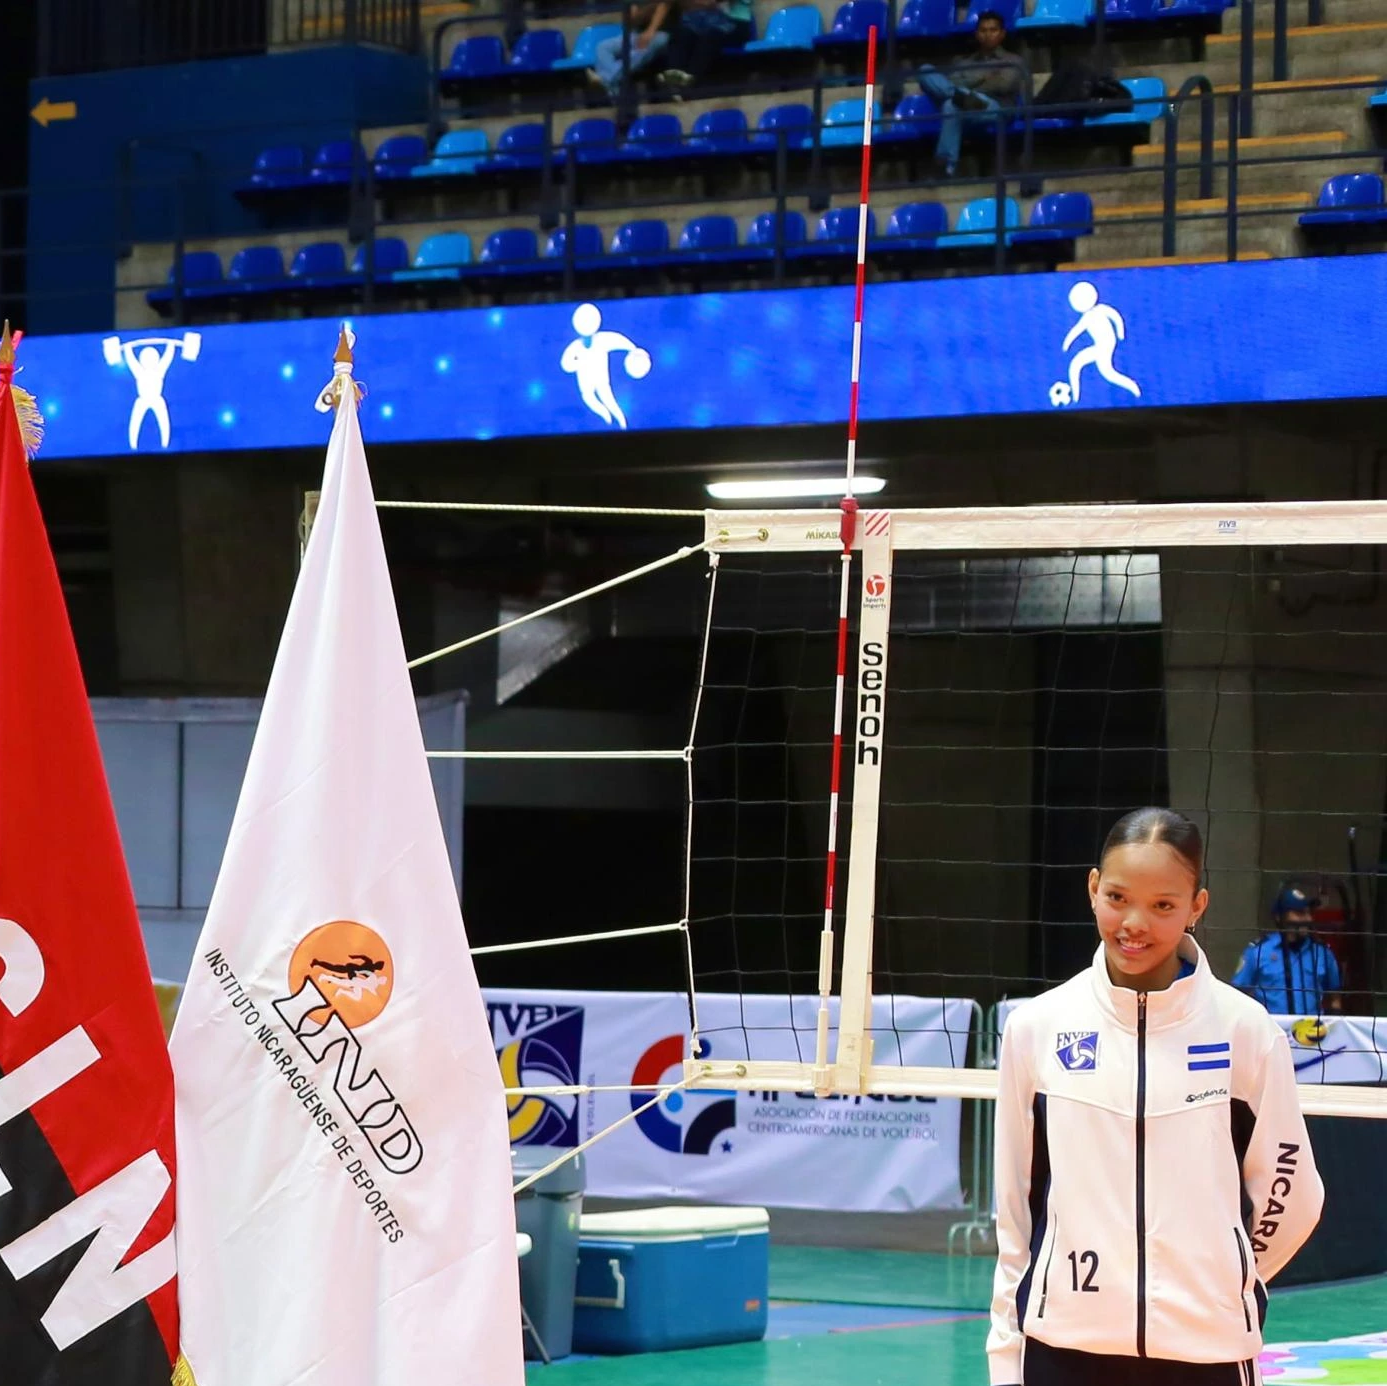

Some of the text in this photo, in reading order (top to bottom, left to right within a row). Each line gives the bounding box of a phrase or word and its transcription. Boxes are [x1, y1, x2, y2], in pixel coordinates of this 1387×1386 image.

[857, 642, 883, 766] Senoh
[204, 947, 404, 1245] INSTITUTO NICARAGÜENSE DE DEPORTES
[272, 975, 424, 1175] IND
[747, 1123, 860, 1137] CENTROAMERICANAS
[862, 1127, 877, 1138] DE
[753, 1106, 931, 1124] ASOCIACIÓN DE FEDERACIONES
[1250, 1142, 1300, 1265] NICARA
[1068, 1249, 1100, 1292] 12
